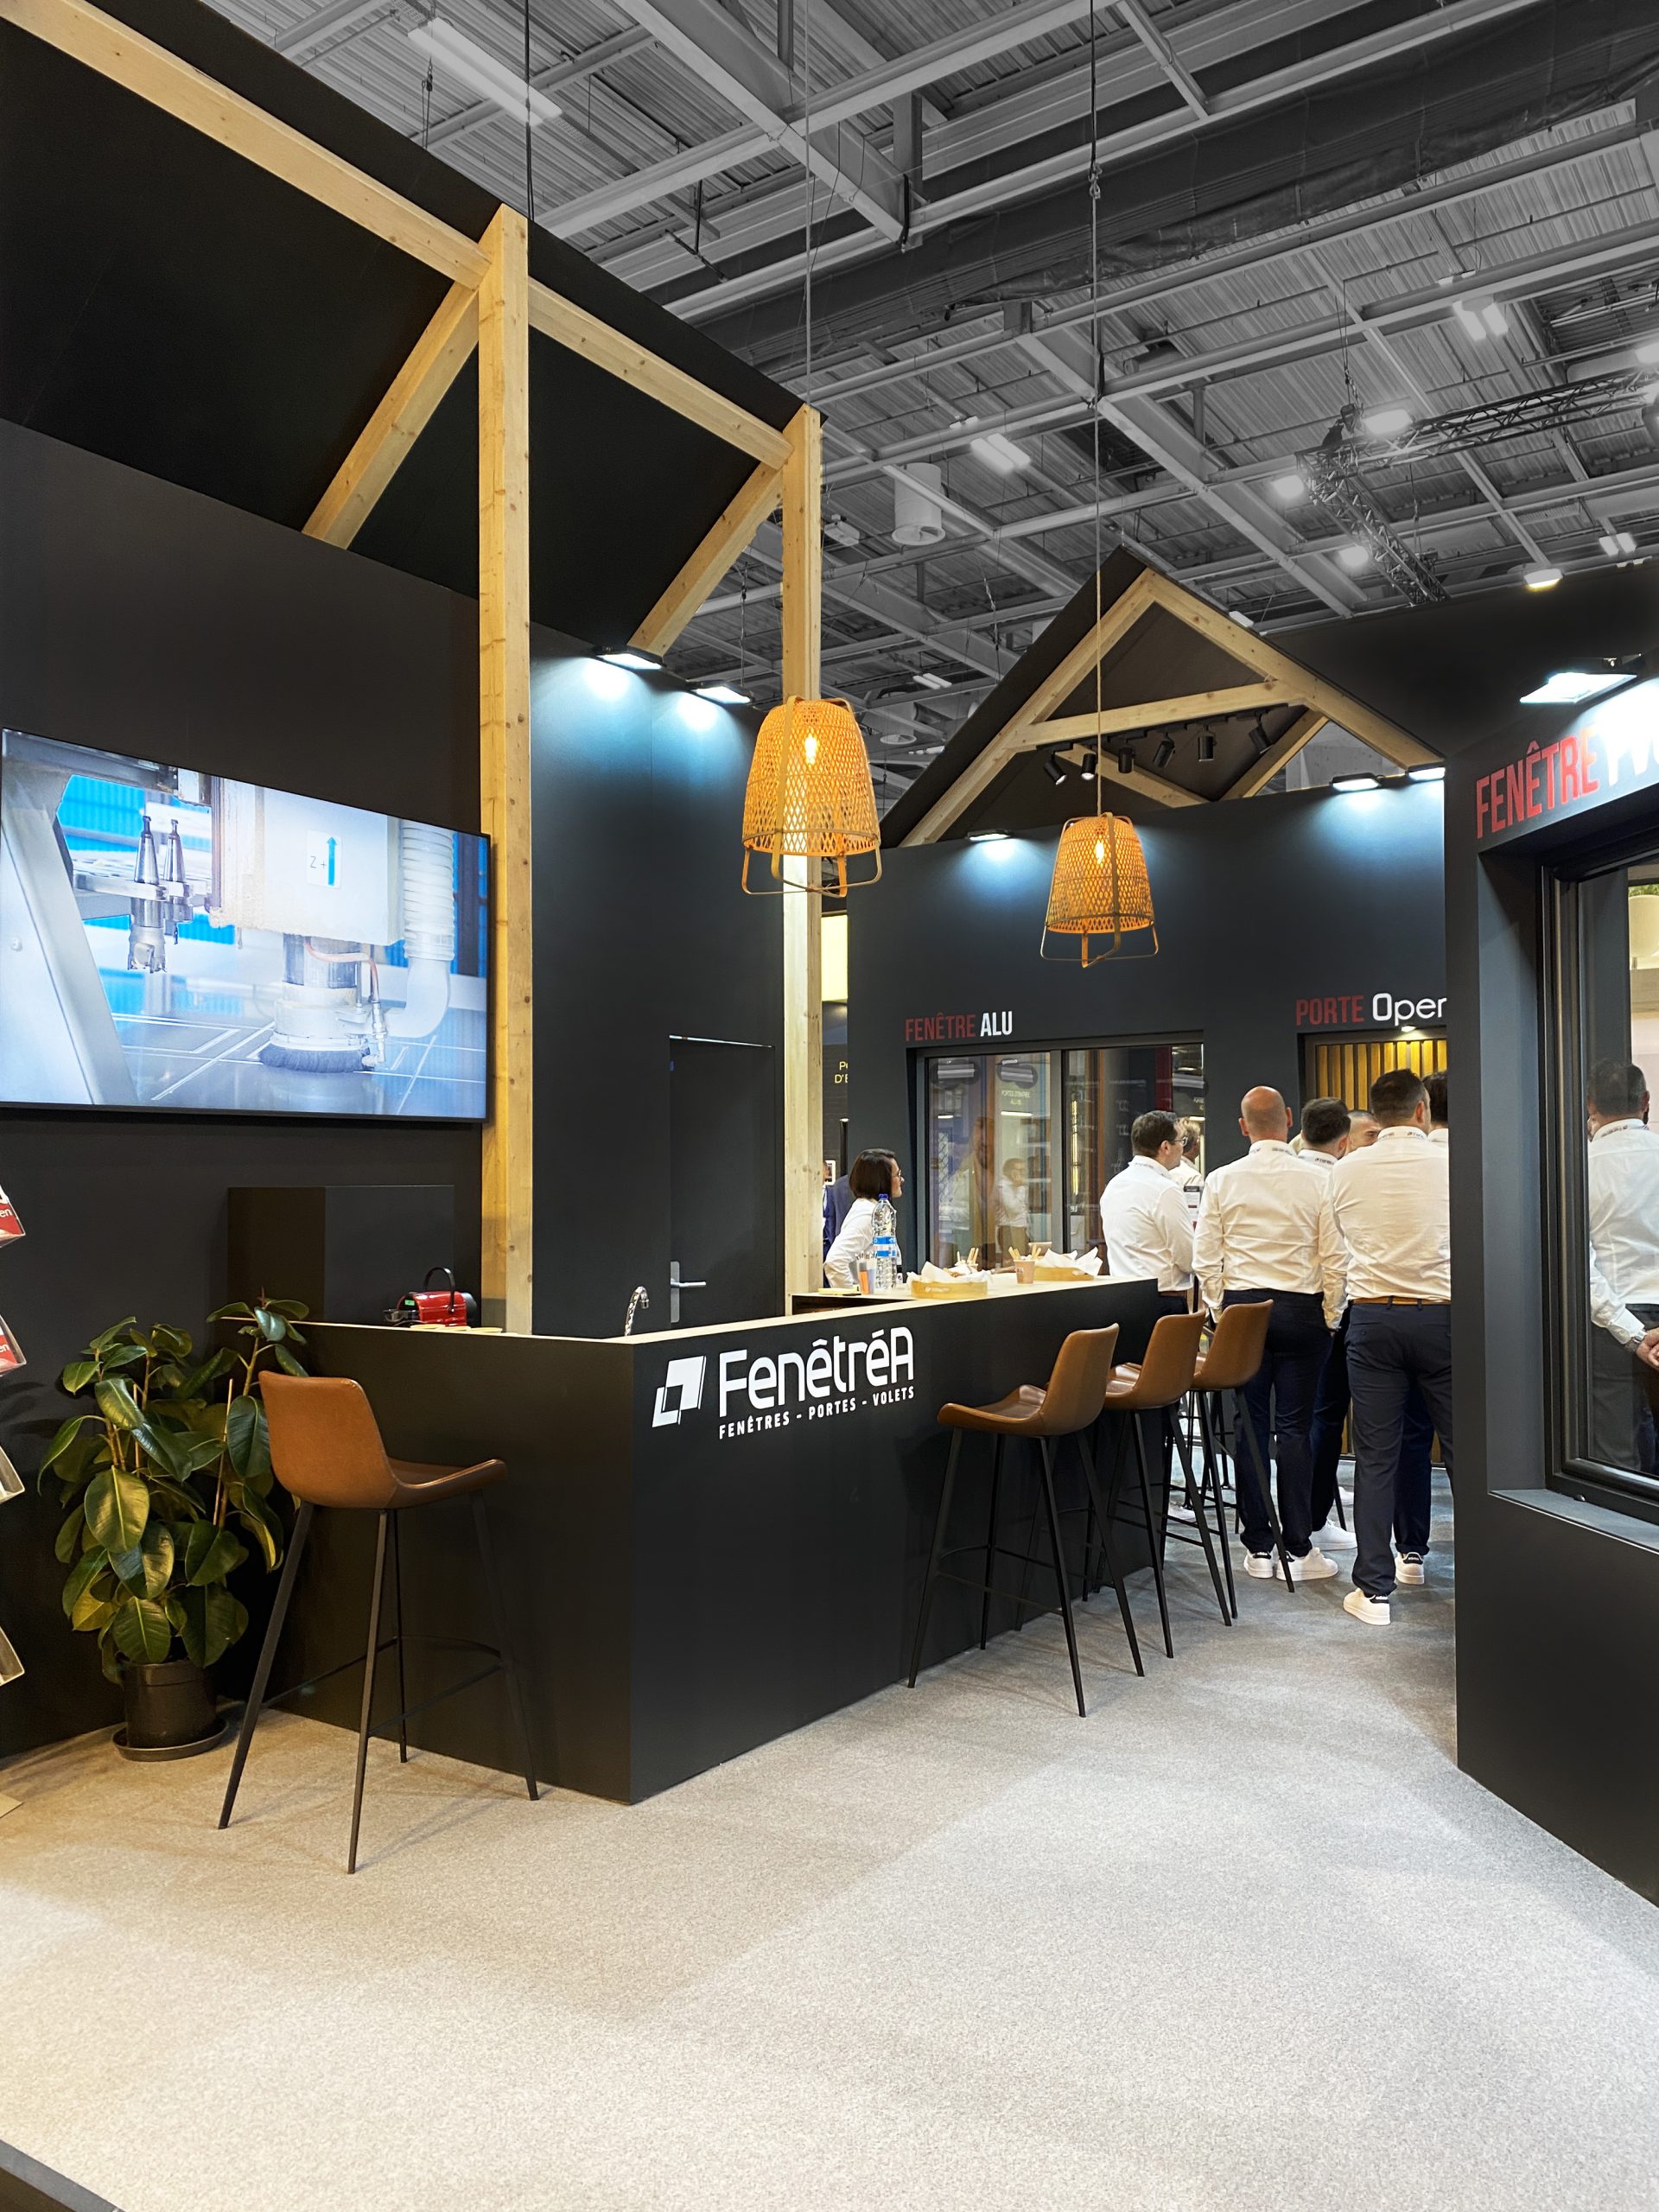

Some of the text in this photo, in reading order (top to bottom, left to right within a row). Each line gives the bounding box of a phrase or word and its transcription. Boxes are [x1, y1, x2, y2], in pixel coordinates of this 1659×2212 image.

[1476, 727, 1599, 840] FENÊTRE
[905, 1010, 1013, 1041] FENÊTRE ALU
[1295, 995, 1364, 1026] PORTE
[719, 1411, 790, 1440] FENÊTRES
[809, 1397, 856, 1420] PORTES
[873, 1385, 914, 1407] VOLETS
